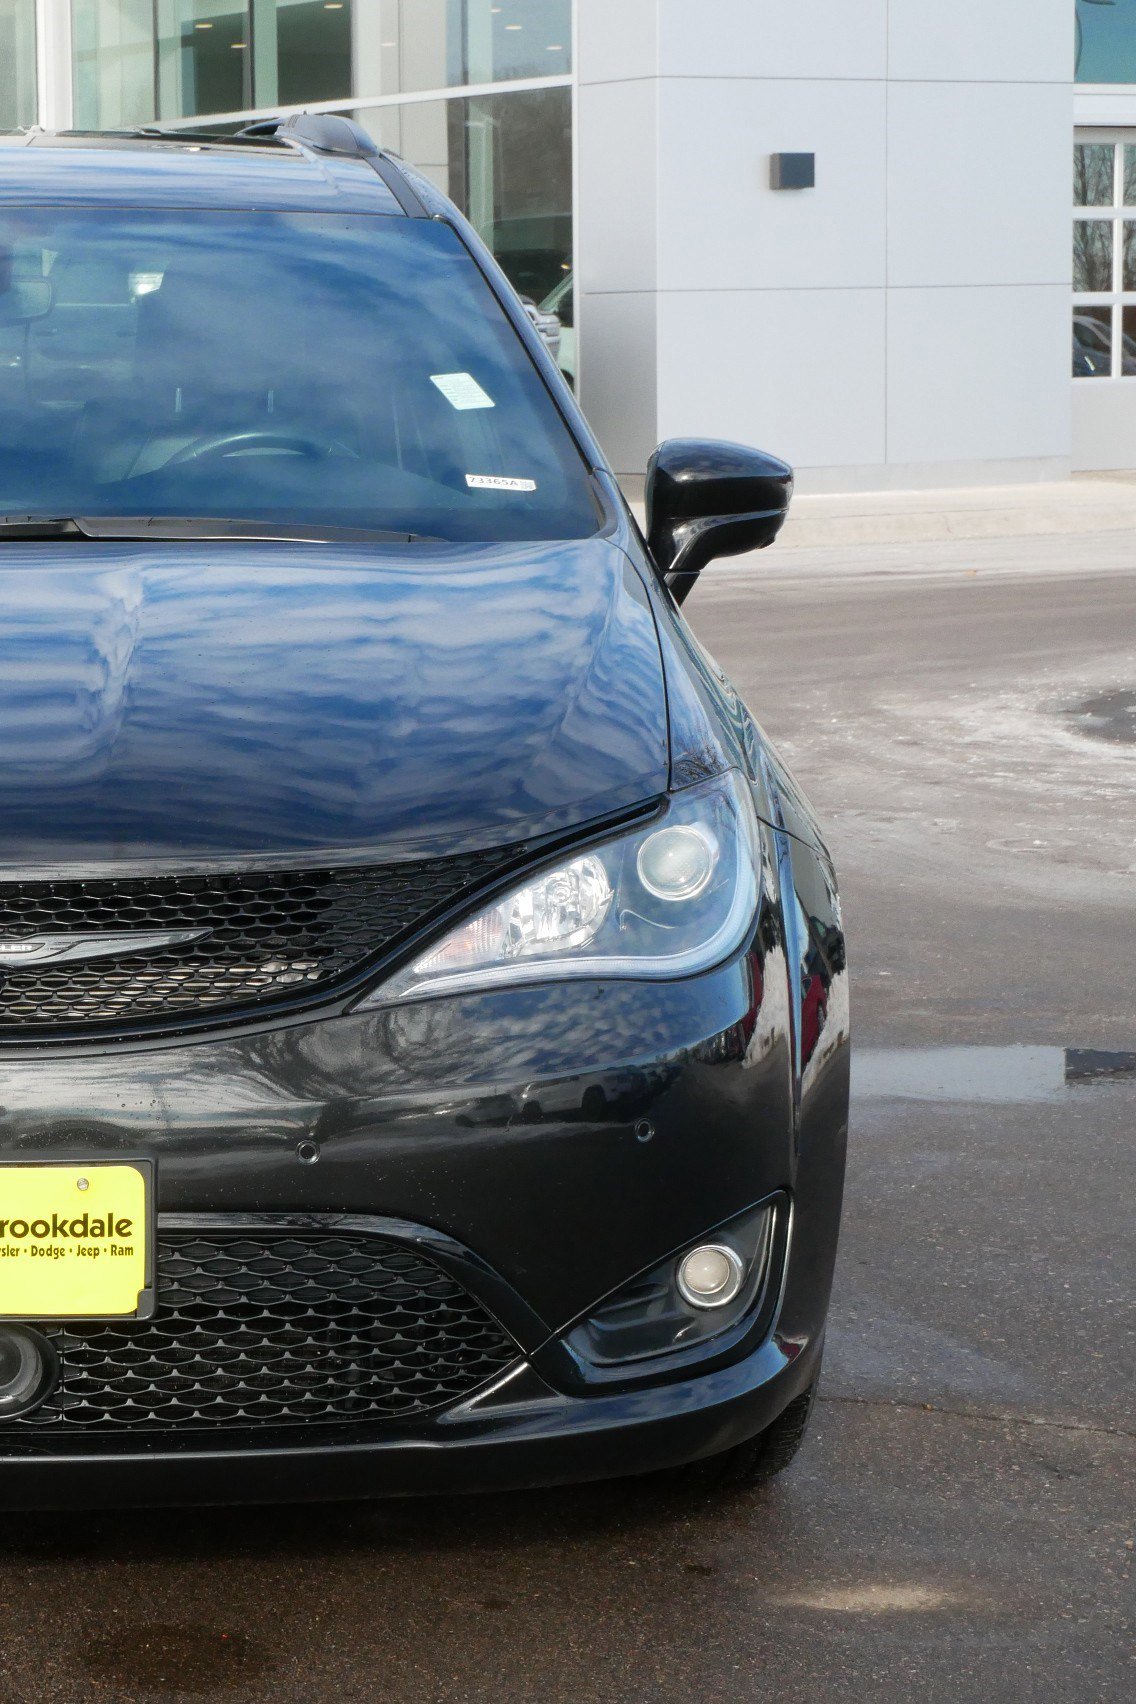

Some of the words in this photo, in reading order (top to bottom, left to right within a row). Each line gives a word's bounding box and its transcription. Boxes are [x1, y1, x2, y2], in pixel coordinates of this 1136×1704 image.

[30, 1245, 66, 1260] Dodge
[76, 1245, 100, 1259] Jeep
[110, 1244, 134, 1257] Ram
